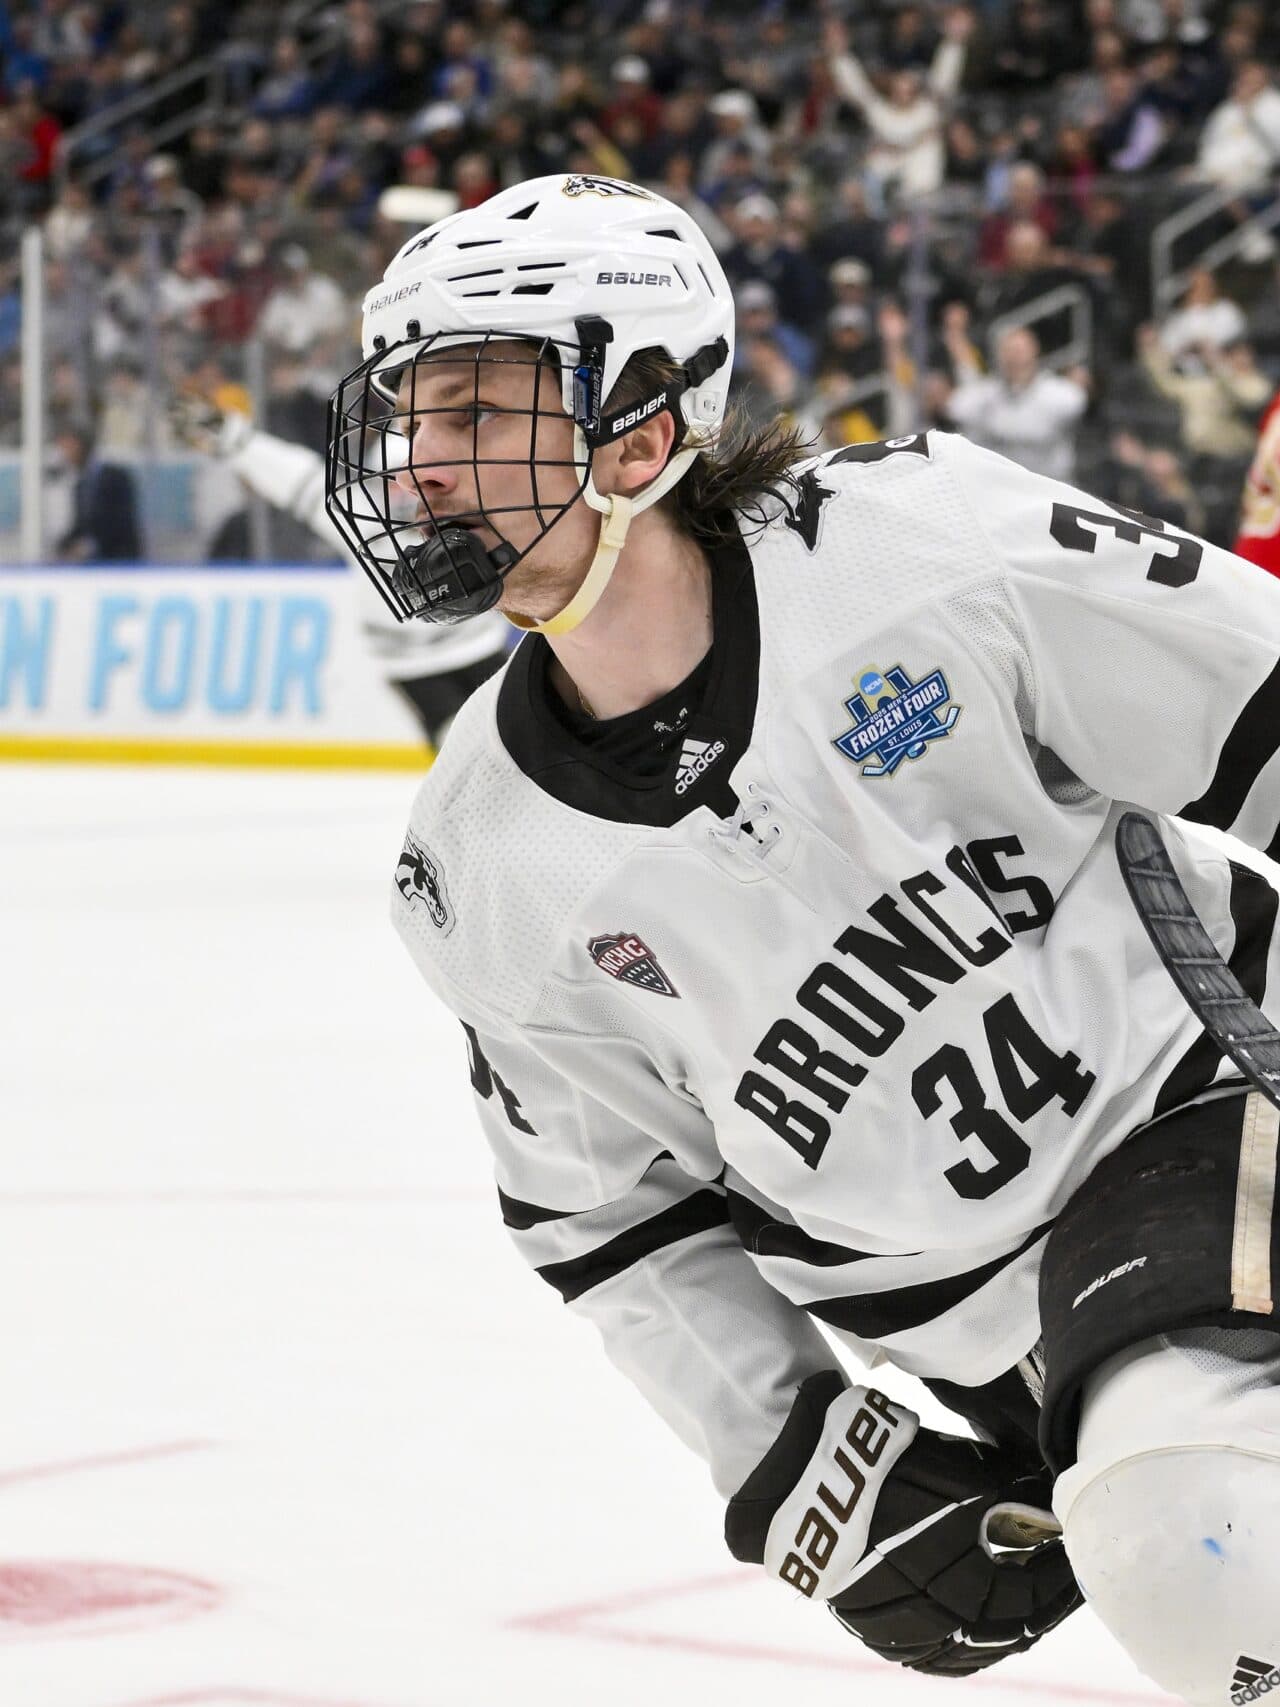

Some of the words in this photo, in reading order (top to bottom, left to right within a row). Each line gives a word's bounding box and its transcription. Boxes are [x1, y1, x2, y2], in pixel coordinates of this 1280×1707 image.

[596, 271, 672, 288] BAUER
[612, 392, 667, 433] BAUER
[88, 594, 330, 716] FOUR
[849, 705, 906, 755] FROZEN
[903, 681, 944, 718] FOUR
[887, 736, 901, 748] ST.
[900, 719, 923, 739] LOUIS
[675, 740, 725, 795] adidas
[598, 938, 648, 977] NCHC
[734, 834, 1055, 1171] BRONCOS
[911, 993, 1097, 1200] 34
[779, 1388, 906, 1598] BAUER
